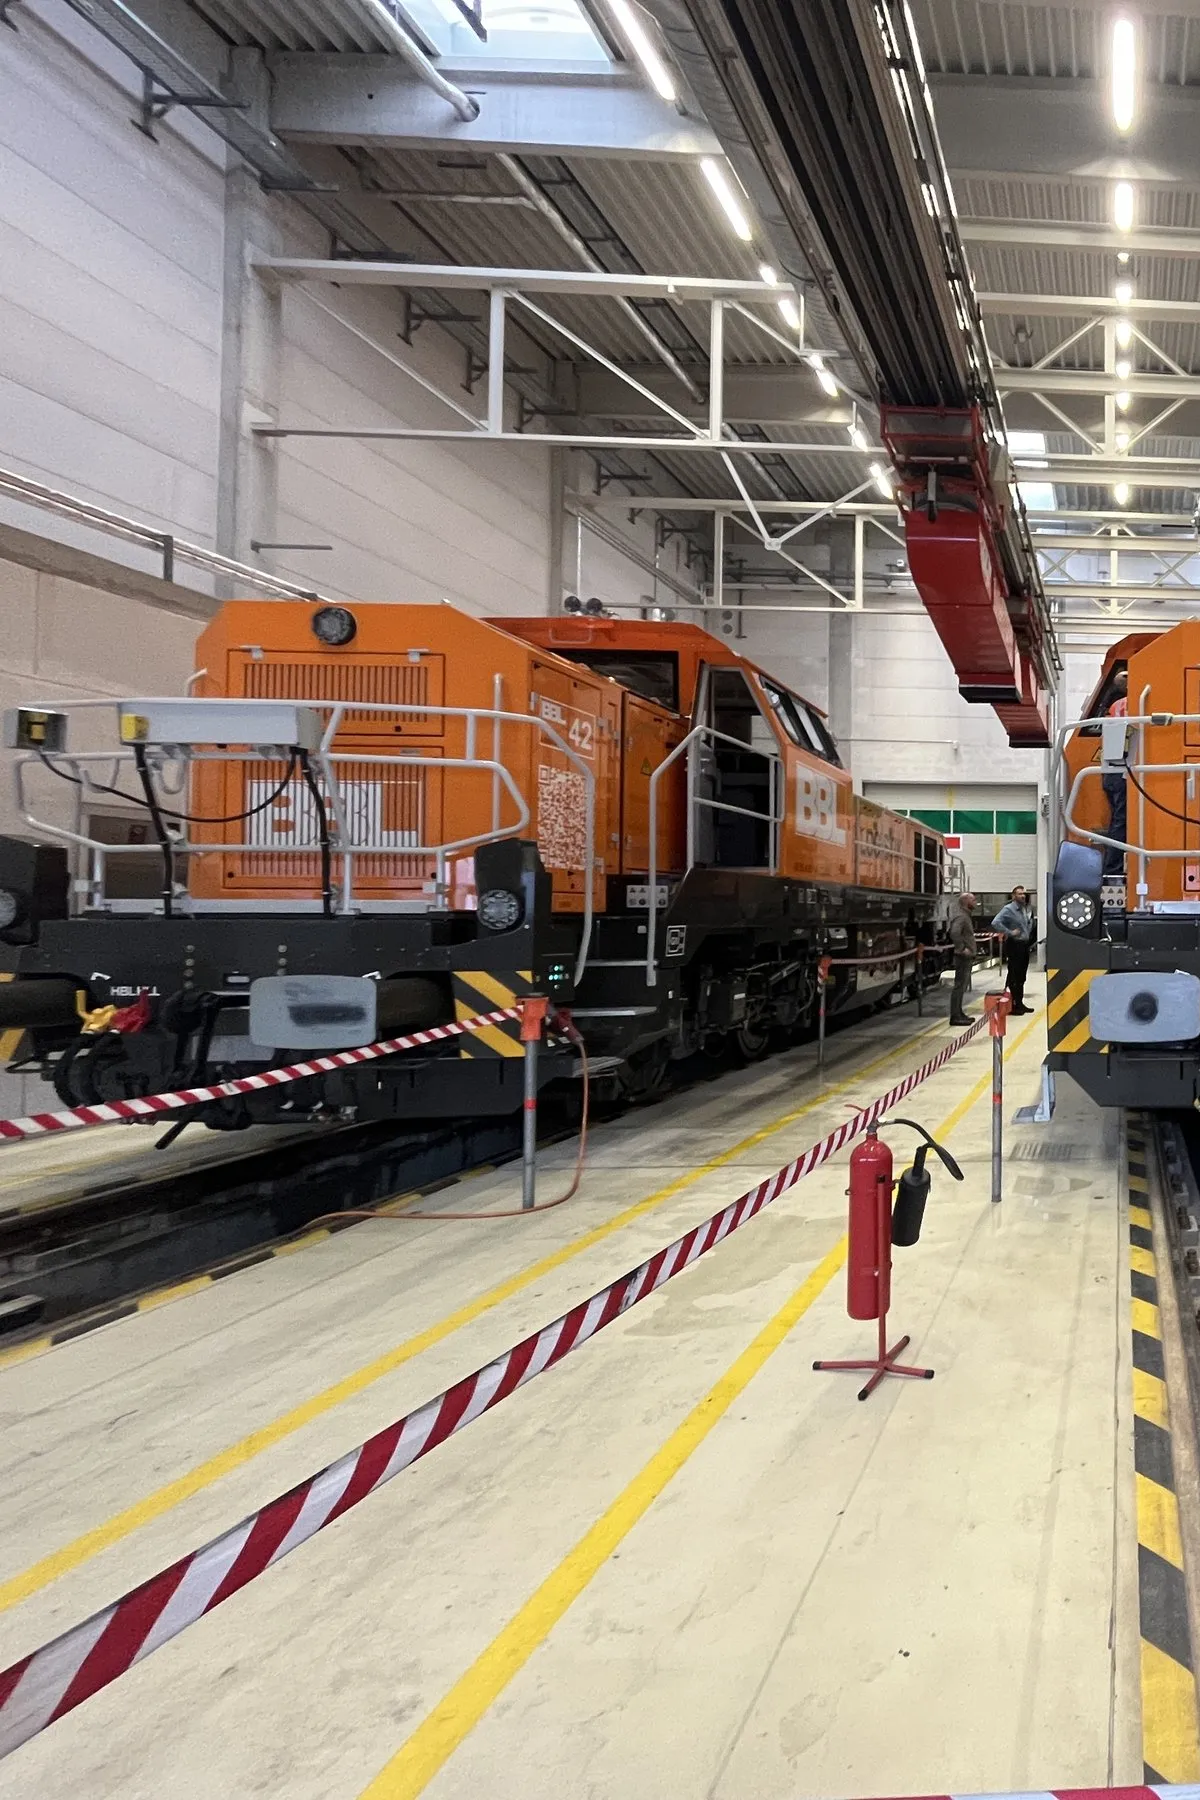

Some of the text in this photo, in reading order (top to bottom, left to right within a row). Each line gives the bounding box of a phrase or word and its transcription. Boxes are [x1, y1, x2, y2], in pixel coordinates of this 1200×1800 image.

[541, 700, 593, 750] BBL 42
[251, 782, 419, 849] BBL
[796, 762, 847, 847] BBL
[110, 986, 137, 996] HBL
